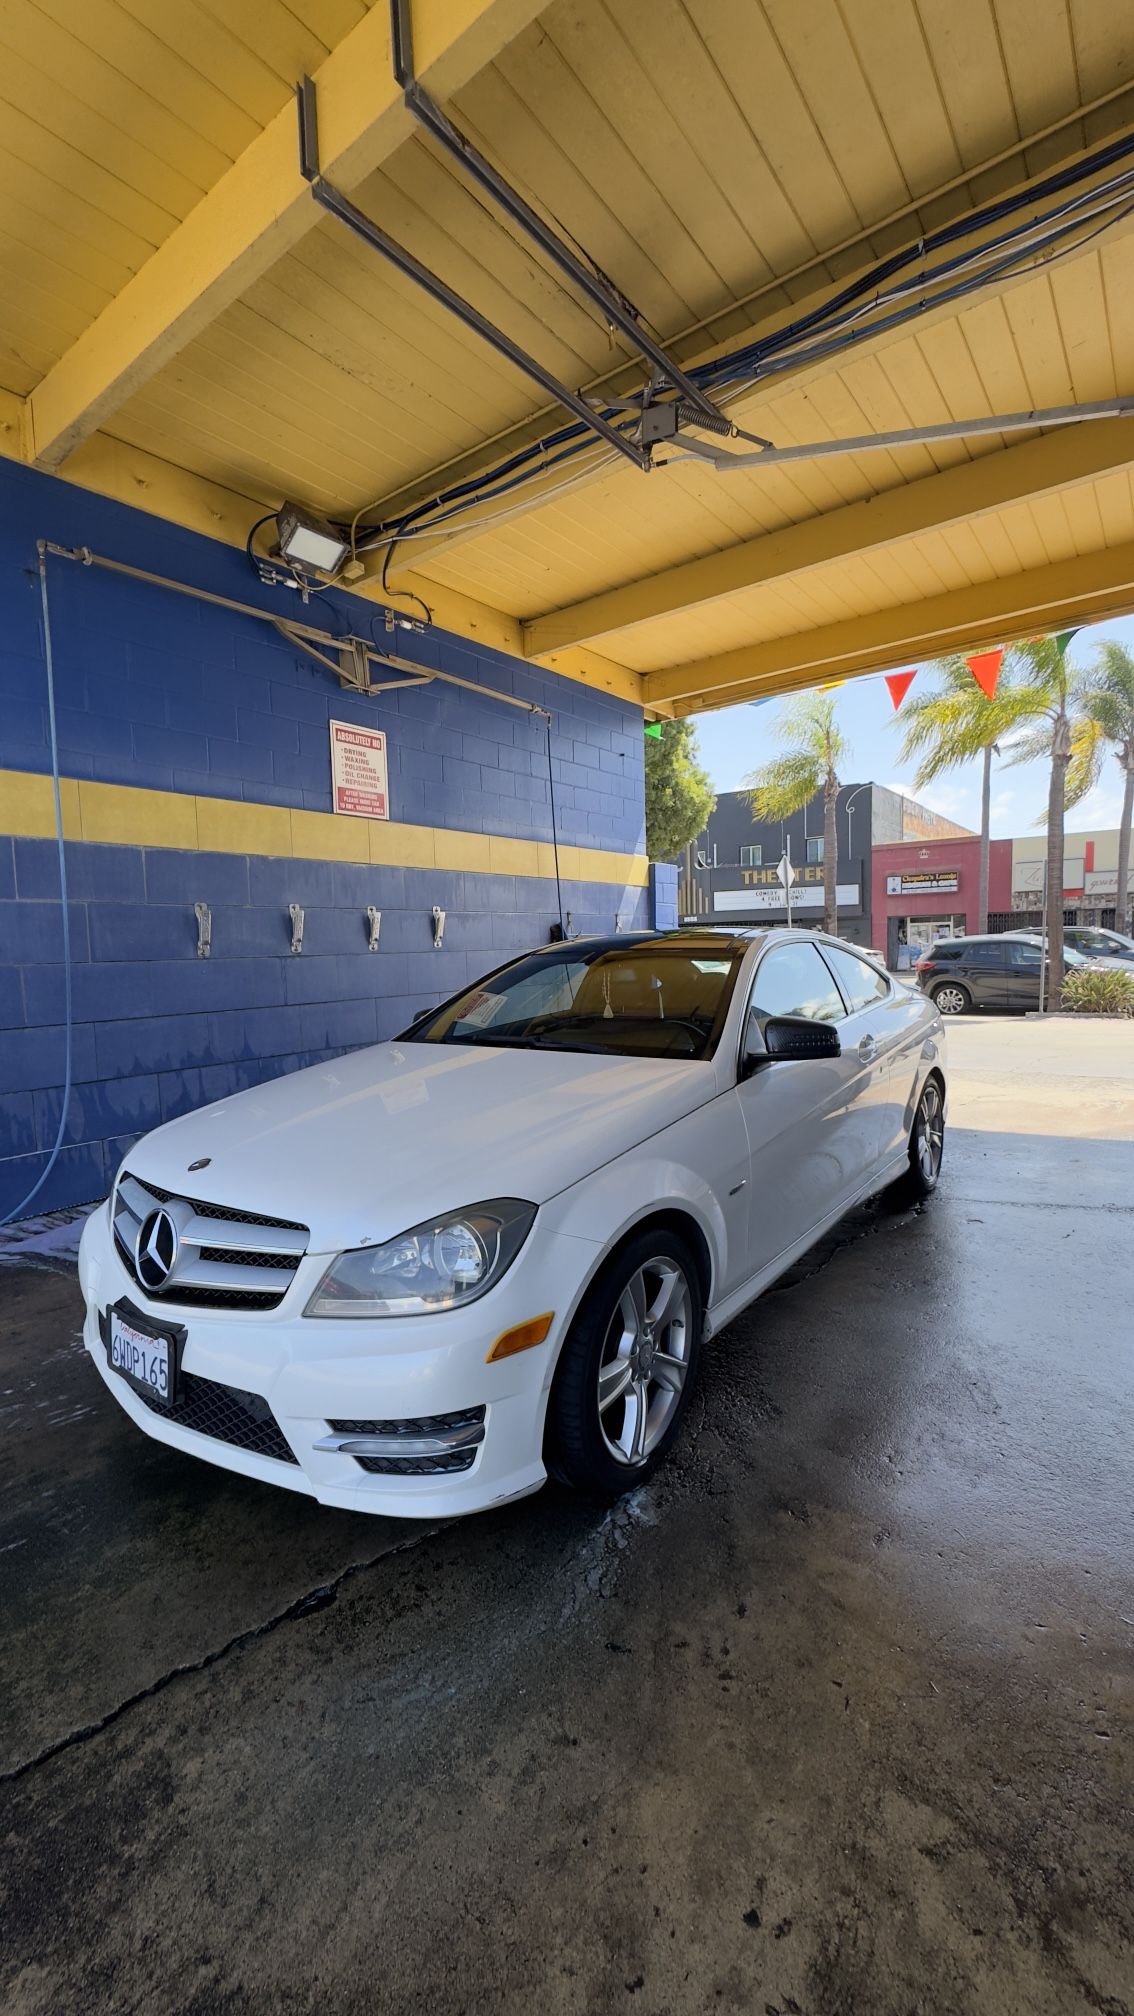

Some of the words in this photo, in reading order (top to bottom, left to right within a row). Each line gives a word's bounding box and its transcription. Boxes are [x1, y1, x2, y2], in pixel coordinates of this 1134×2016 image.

[337, 731, 370, 745] ABSOLUTELY
[372, 739, 380, 748] NO
[344, 748, 366, 757] DRYING
[344, 755, 369, 765] WAXING
[344, 762, 377, 774] POLISHING
[344, 770, 355, 778] OIL
[356, 772, 381, 783] CHANGE
[345, 778, 378, 789] REPAIRING
[742, 867, 825, 884] THETER
[112, 1335, 168, 1391] 6WDP165
